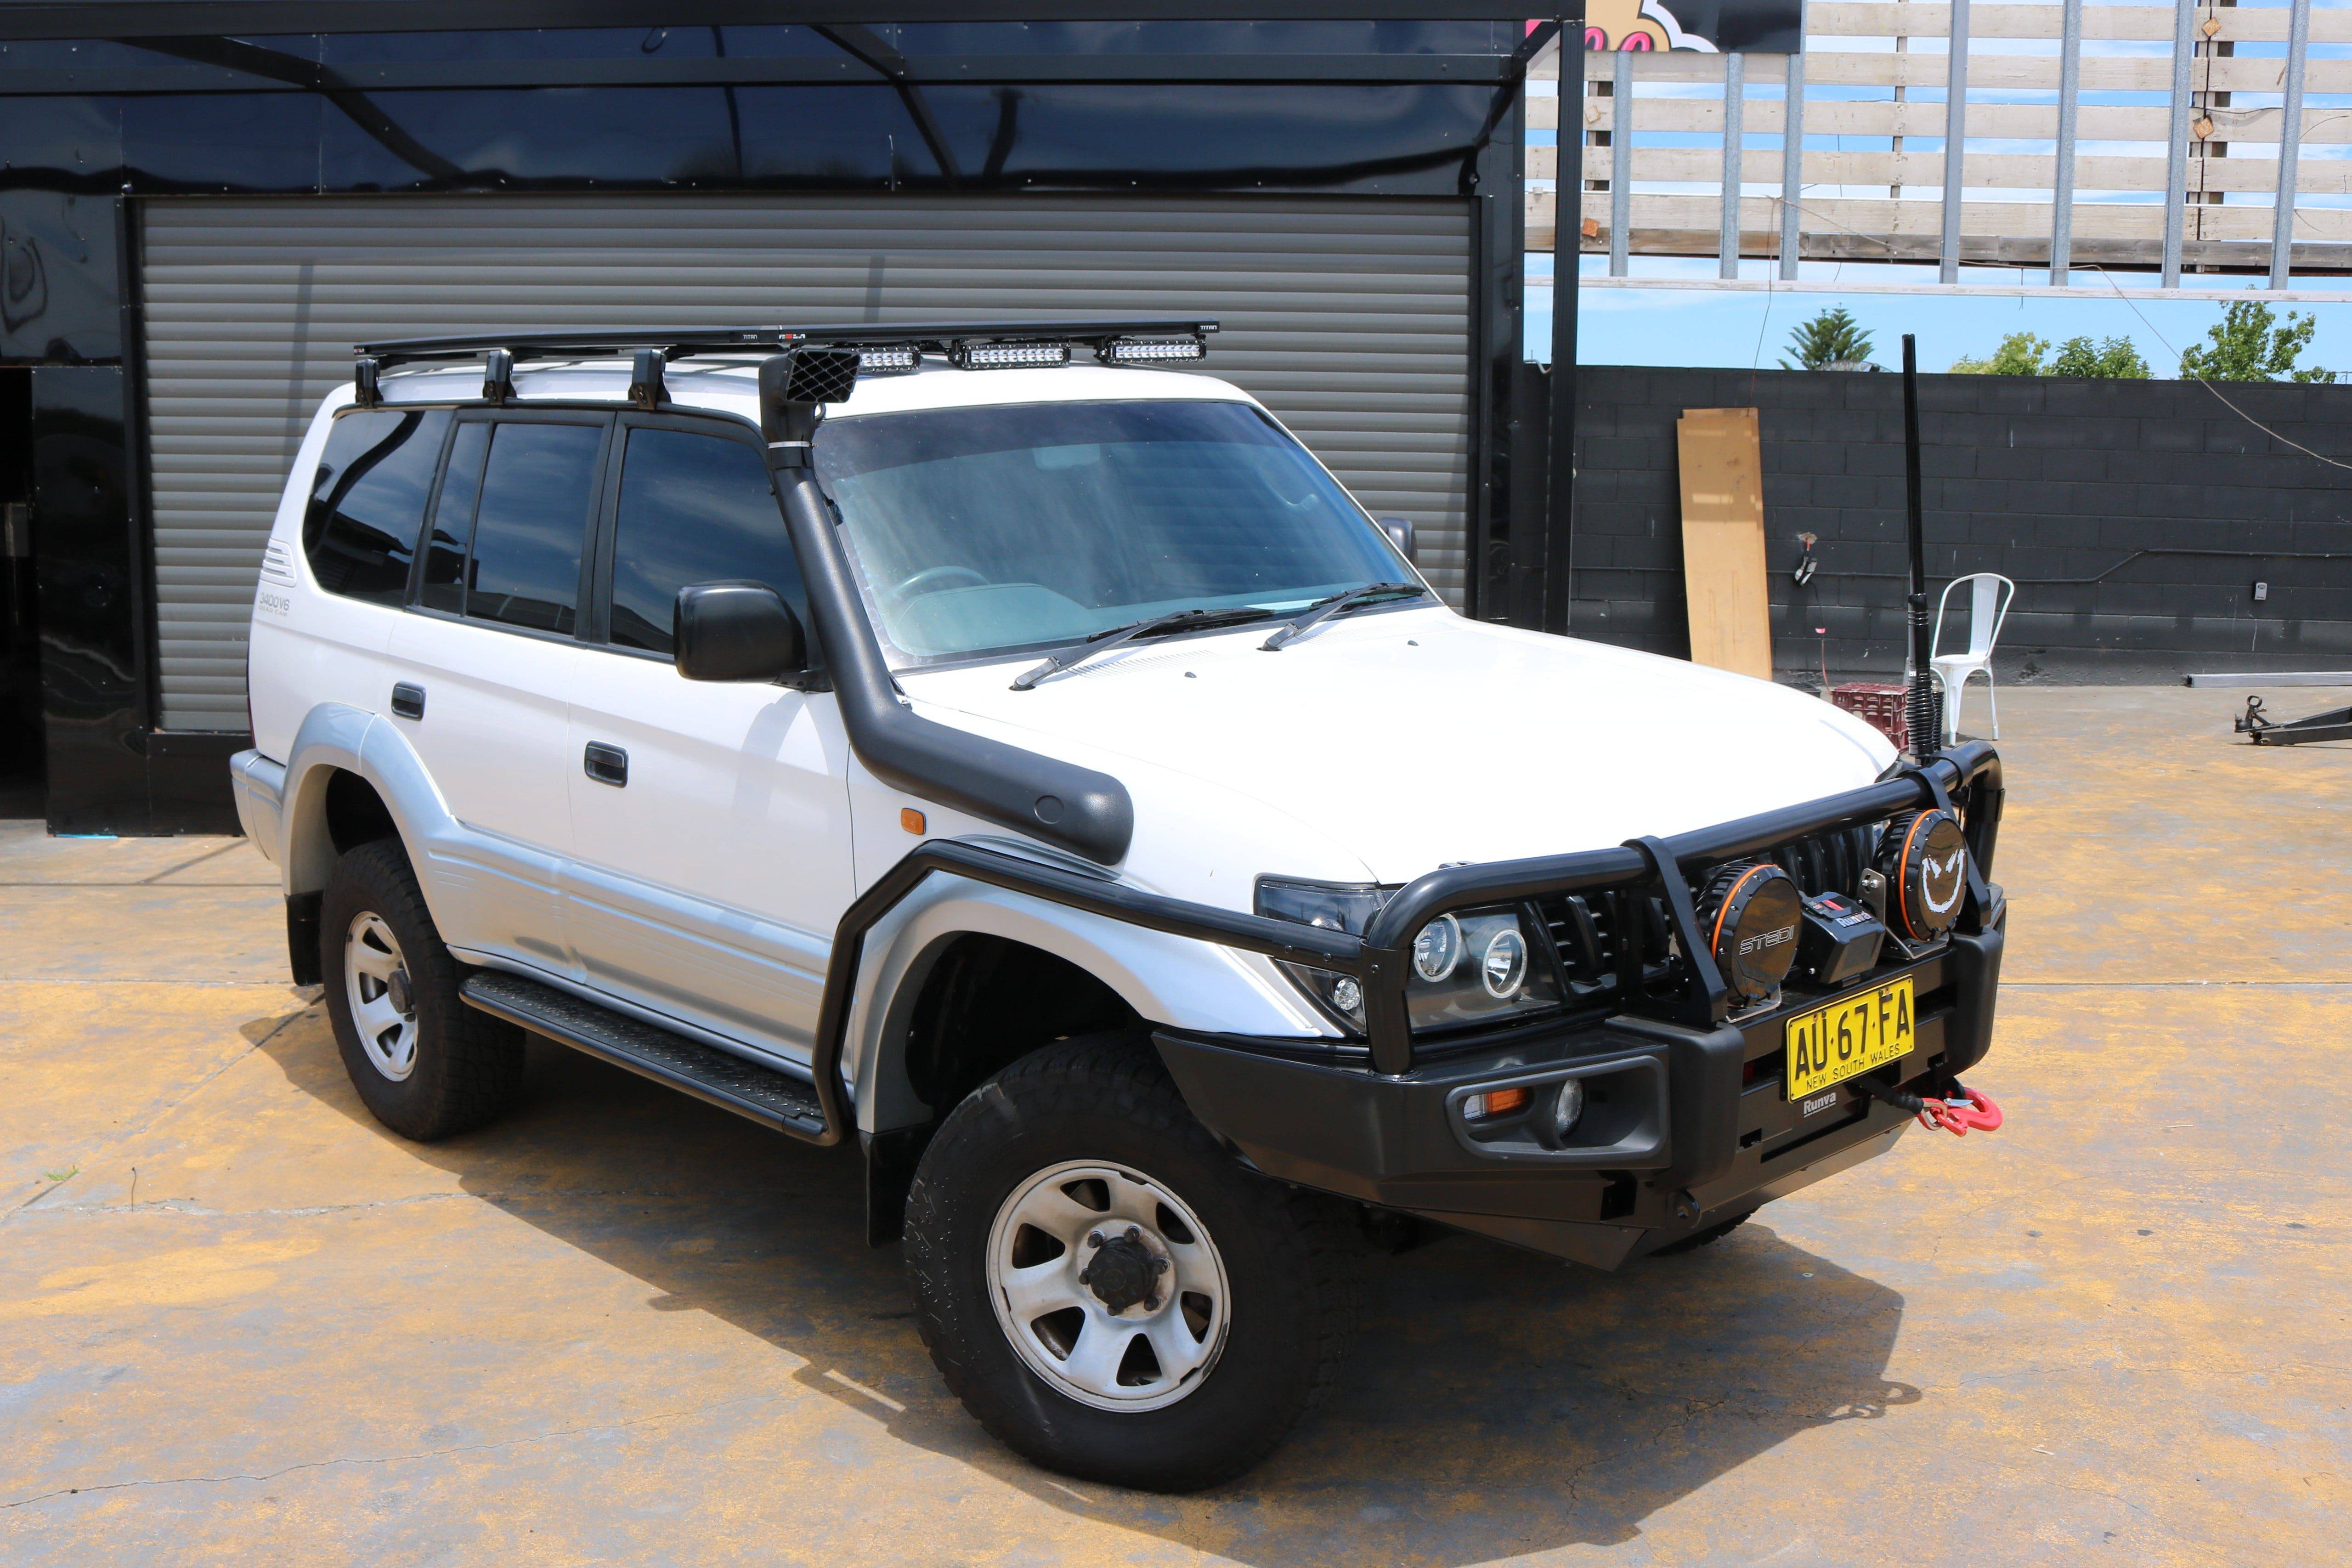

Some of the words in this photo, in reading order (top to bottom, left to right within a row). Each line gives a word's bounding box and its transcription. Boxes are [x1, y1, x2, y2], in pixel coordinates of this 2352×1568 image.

[1739, 924, 1795, 956] STEDI
[1806, 1072, 1827, 1091] NEW
[1832, 1057, 1865, 1080] SOUTH
[1870, 1043, 1900, 1064] WALES
[1803, 1092, 1837, 1115] Runva
